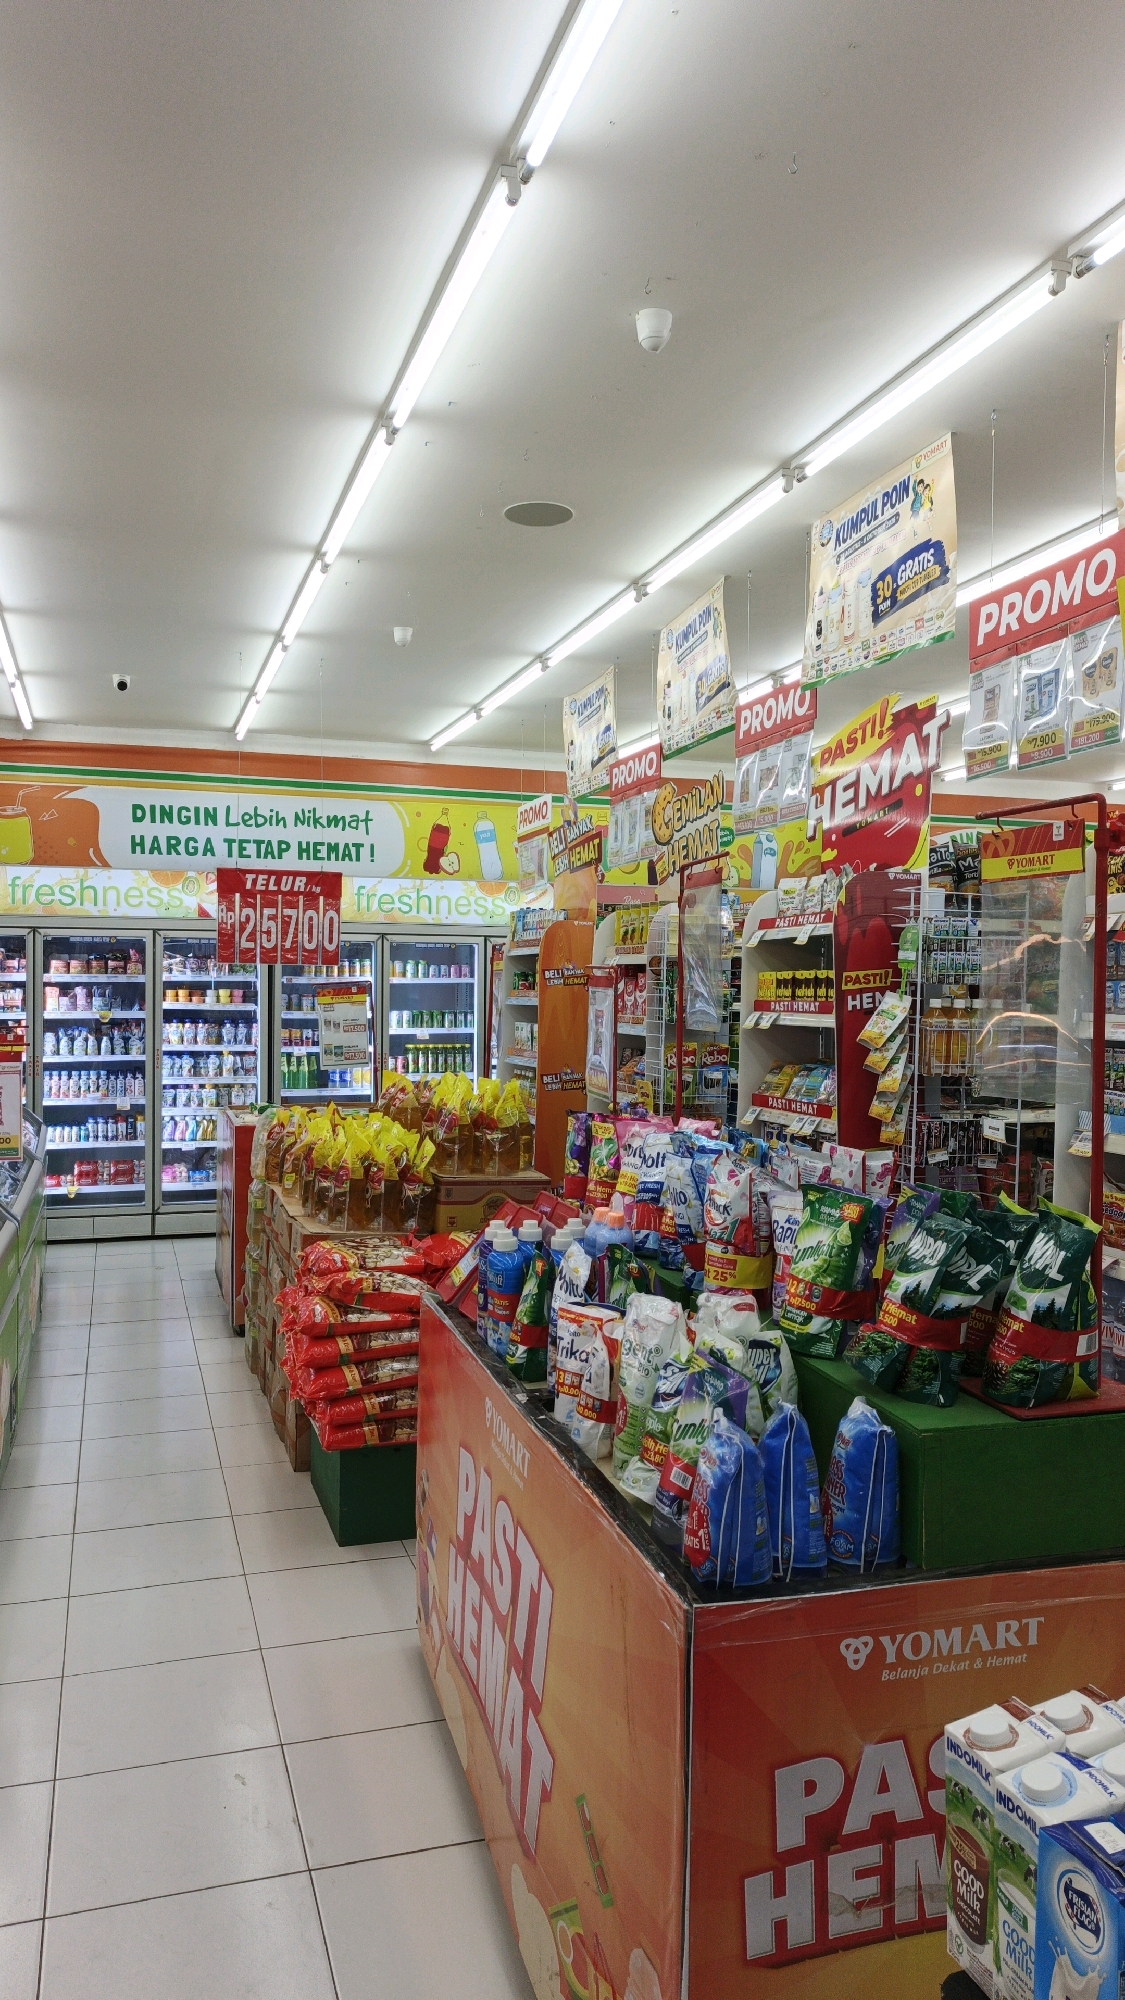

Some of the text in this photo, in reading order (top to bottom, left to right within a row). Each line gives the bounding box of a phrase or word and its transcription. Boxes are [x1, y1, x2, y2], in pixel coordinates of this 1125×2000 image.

[834, 498, 879, 552] KUMPUL
[881, 474, 911, 516] POIN
[897, 548, 934, 585] GRATIS
[876, 574, 892, 604] 30
[977, 548, 1116, 646] PROMO
[738, 688, 810, 740] PROMO
[819, 698, 890, 771] PASTI!
[612, 751, 657, 791] PROMO
[806, 709, 951, 841] HEMAT
[131, 803, 374, 836] DINGIN Lebih Nikmat
[519, 800, 548, 830] PROMO
[855, 806, 889, 829] YOMART
[131, 834, 216, 857] HARGA
[223, 838, 291, 860] TETAP
[550, 814, 594, 856] BELI BANYAK
[665, 818, 720, 875] HEMAT
[569, 839, 600, 869] HEMAT
[1016, 854, 1055, 869] YOMART
[8, 876, 185, 909] freshness
[245, 873, 307, 892] TELUR
[355, 885, 506, 917] freshness
[218, 905, 339, 951] Rp 25700
[775, 913, 826, 929] PASTI HEMAT
[544, 970, 563, 979] BELI
[564, 976, 588, 985] HEMAT
[844, 970, 890, 987] PASTI!
[770, 1001, 820, 1012] PASTI HEMAT
[701, 1050, 728, 1064] Rebo
[543, 1074, 561, 1083] BELI
[563, 1081, 586, 1090] HEMAT
[768, 1097, 818, 1115] PASTI HEMAT
[712, 1271, 737, 1283] 25%
[886, 1303, 918, 1324] Hemat
[492, 1402, 531, 1479] YOMART
[830, 1537, 854, 1552] FOAM
[456, 1446, 553, 1702] PASTI
[879, 1616, 1045, 1664] YOMART
[881, 1653, 1027, 1681] Belanja Dekat & Hemat
[446, 1543, 554, 1855] HEMAT
[1027, 1719, 1054, 1740] INDOMILK
[946, 1736, 992, 1787] INDOMILK
[1086, 1770, 1117, 1798] INDOMILK
[953, 1859, 985, 1899] GOOD
[956, 1879, 982, 1914] Milk
[1068, 1891, 1098, 1924] FRISIAN
